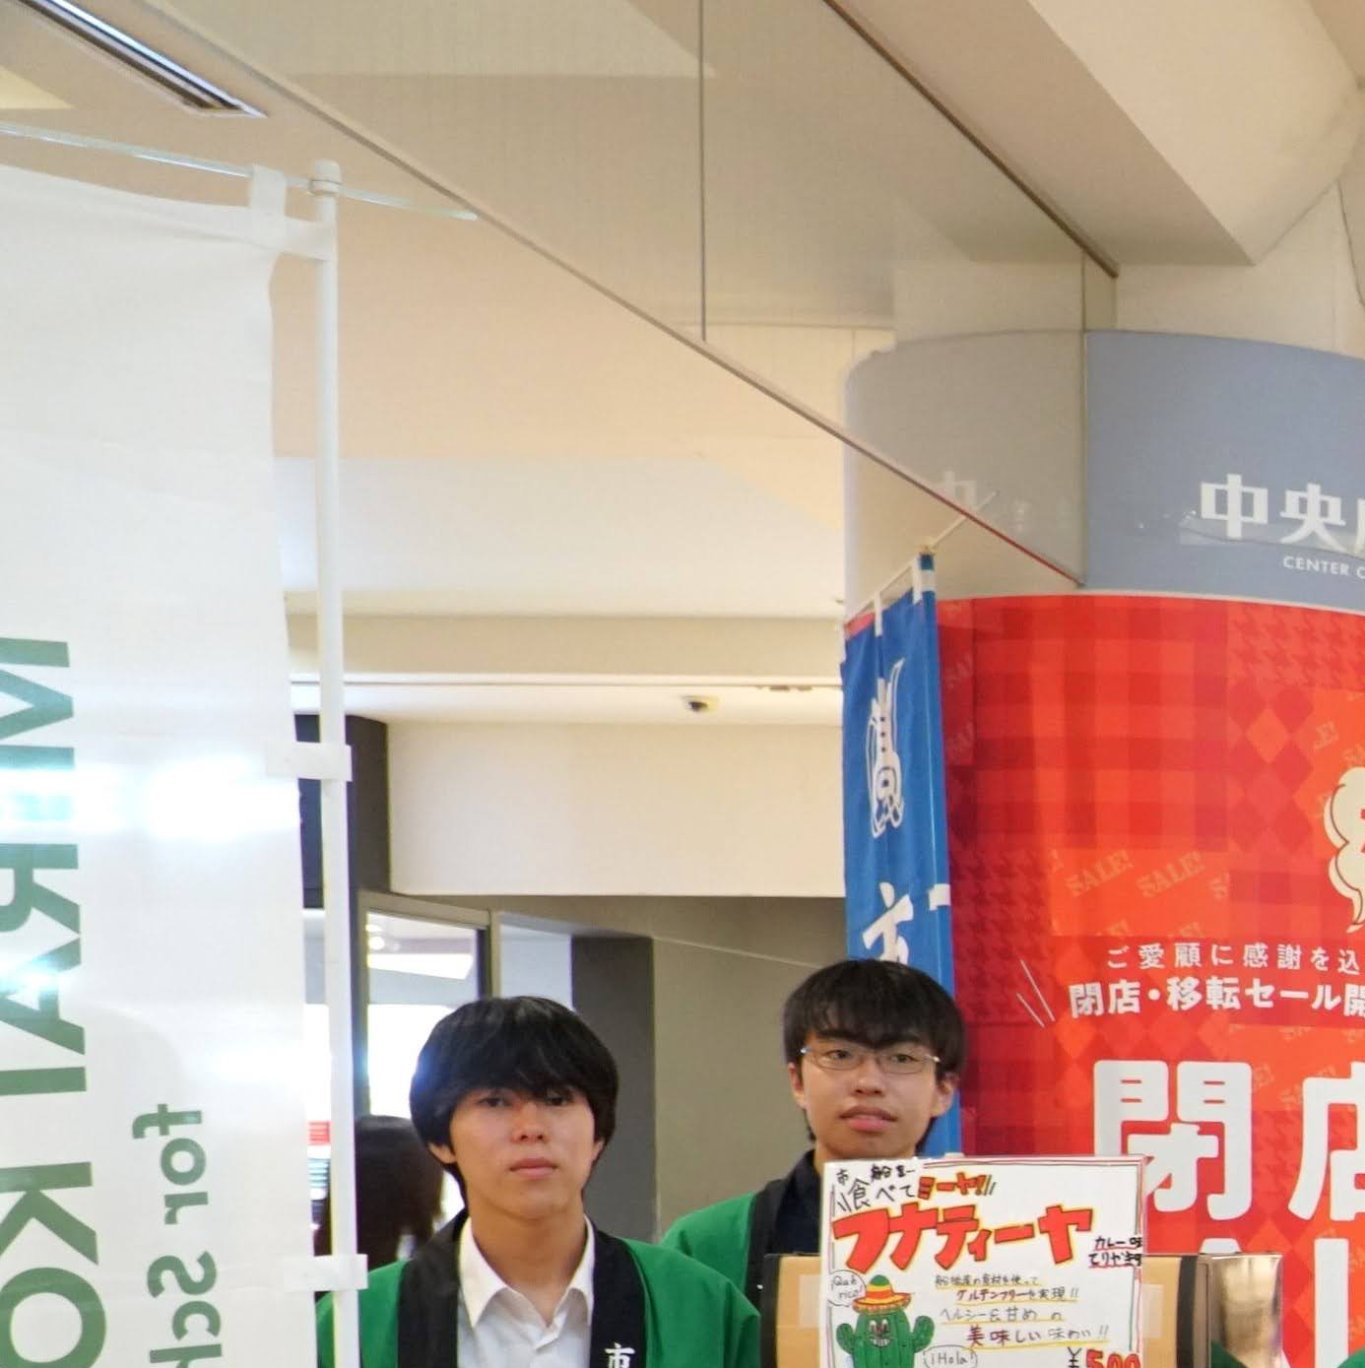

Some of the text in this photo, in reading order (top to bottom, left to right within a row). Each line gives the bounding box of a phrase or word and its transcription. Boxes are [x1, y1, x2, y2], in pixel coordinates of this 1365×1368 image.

[1282, 555, 1351, 575] CENTER
[832, 1201, 1094, 1275] フナティーヤ
